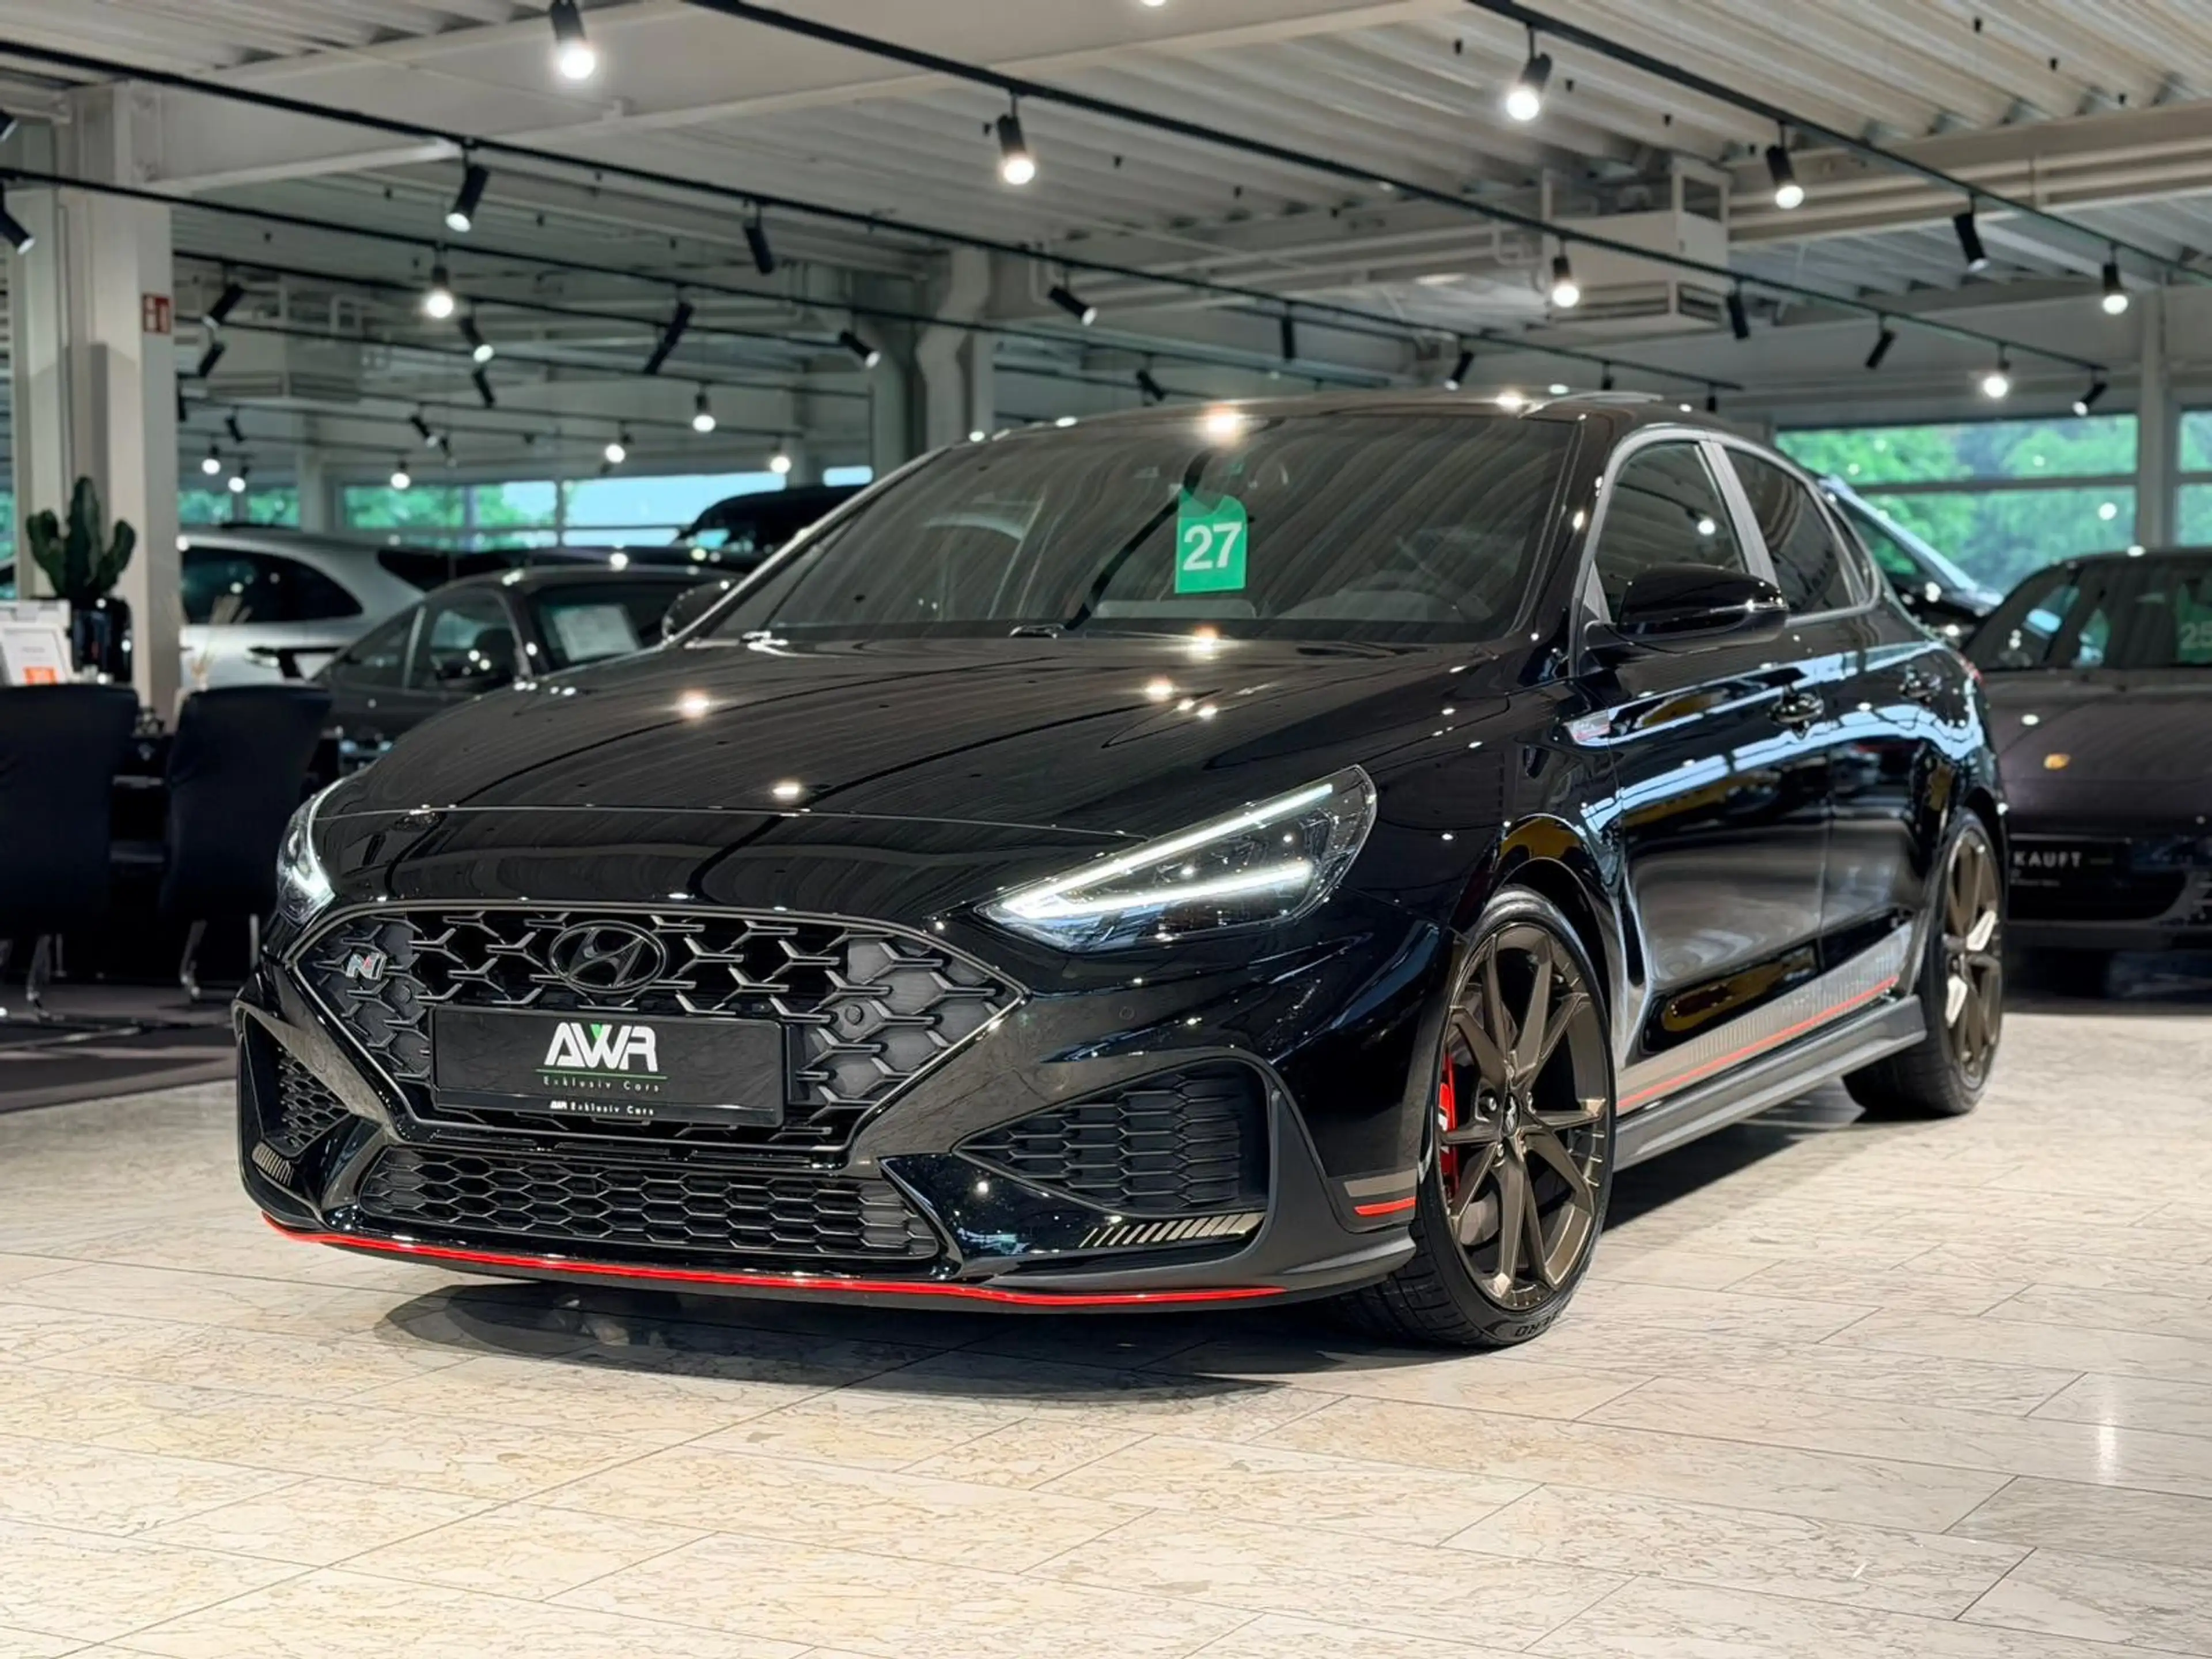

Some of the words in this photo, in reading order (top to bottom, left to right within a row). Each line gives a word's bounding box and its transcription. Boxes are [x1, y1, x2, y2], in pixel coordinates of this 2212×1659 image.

[1183, 521, 1242, 570] 27
[543, 1022, 658, 1072] AWR
[543, 1075, 611, 1088] Exklusiv
[623, 1081, 660, 1092] Cars
[626, 1105, 654, 1116] Cars
